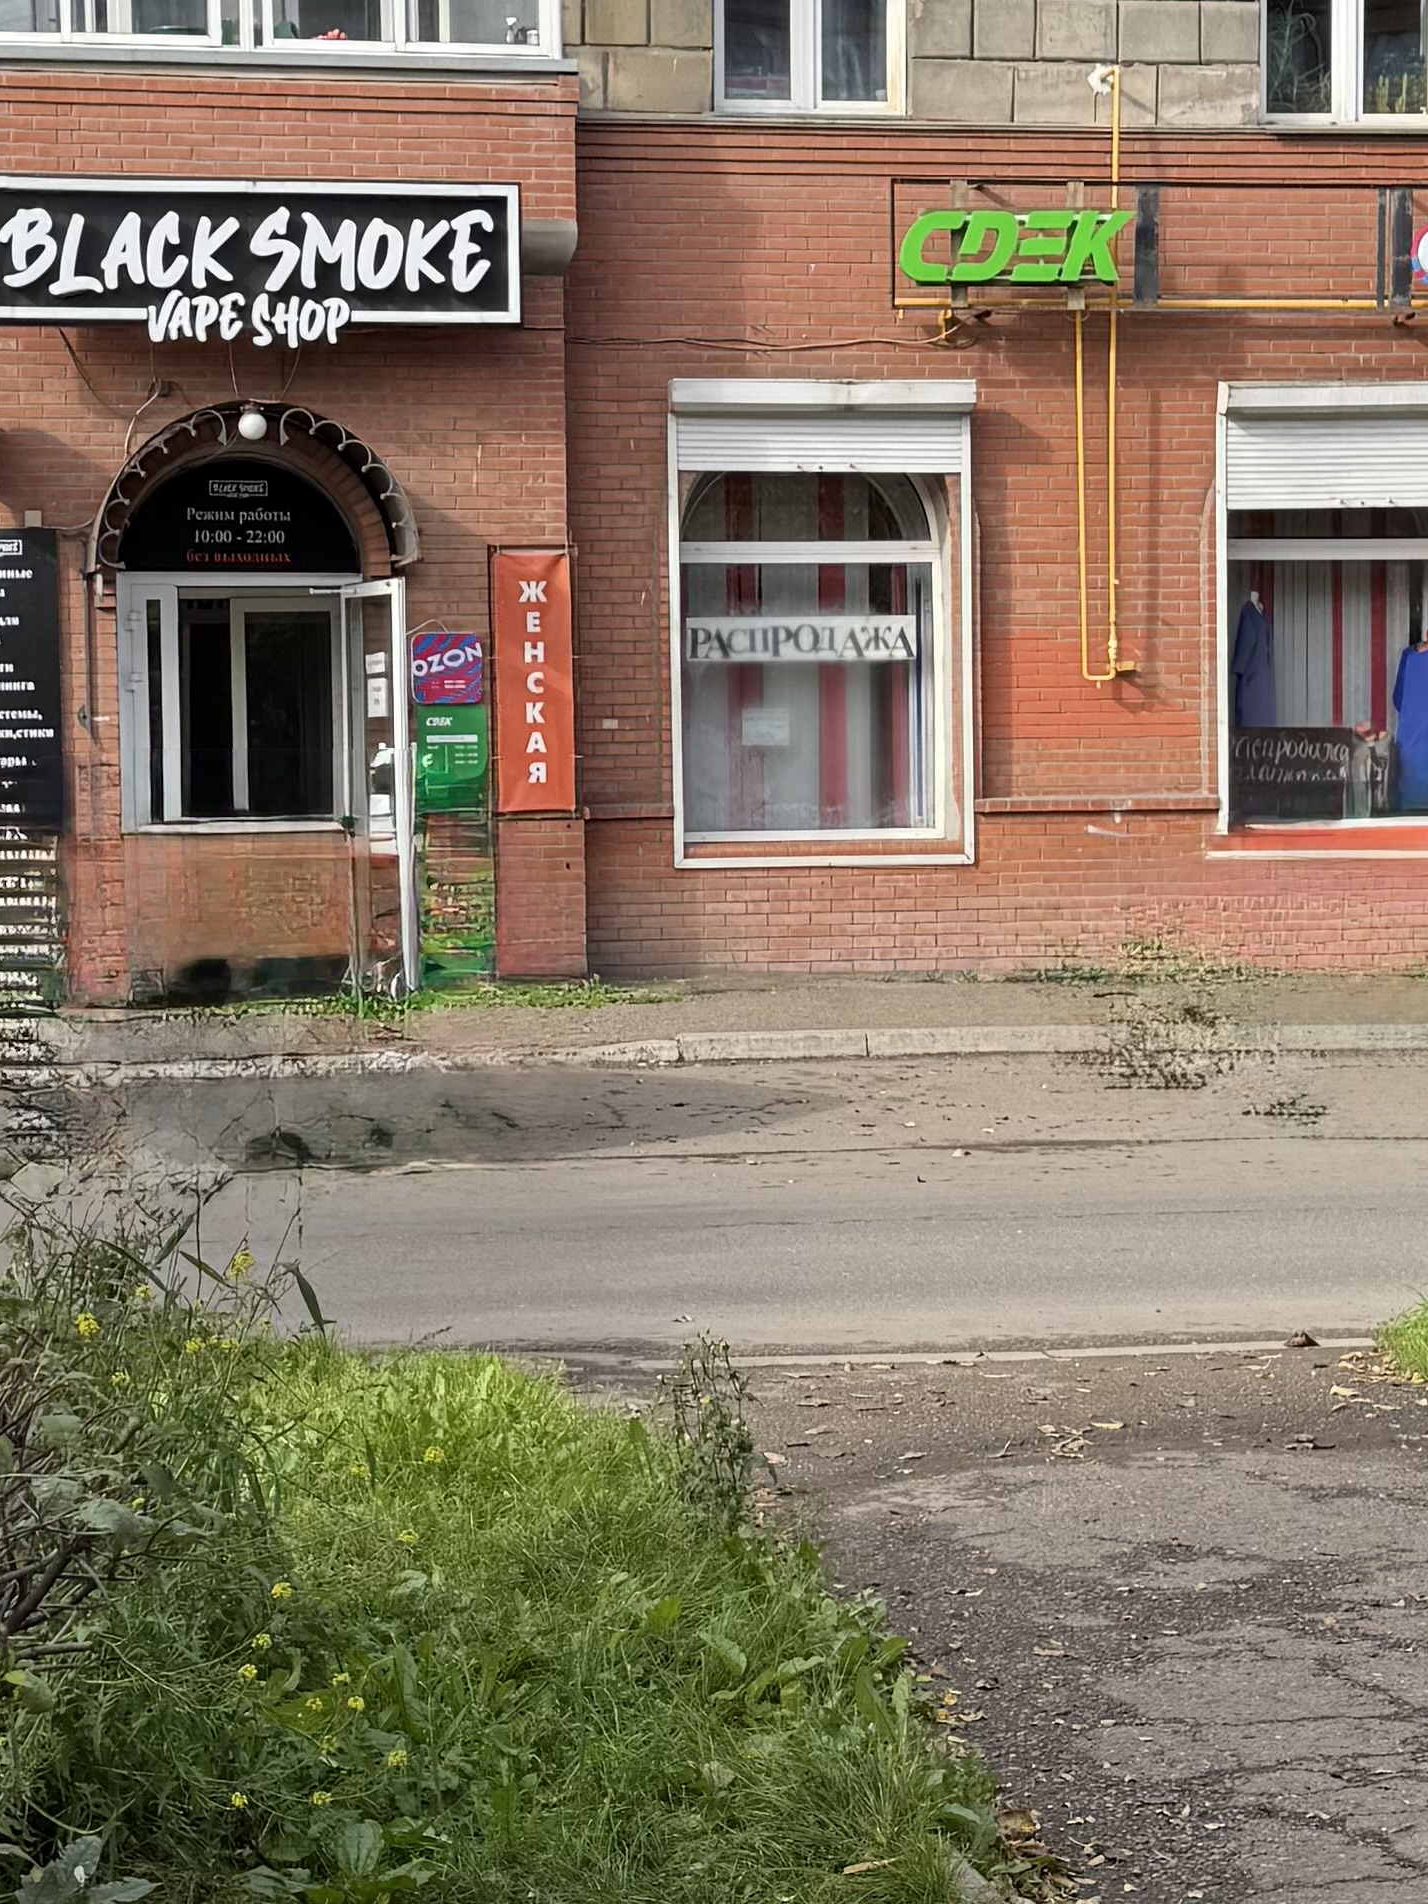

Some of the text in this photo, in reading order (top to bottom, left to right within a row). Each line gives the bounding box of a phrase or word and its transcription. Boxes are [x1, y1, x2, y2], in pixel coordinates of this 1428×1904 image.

[249, 206, 494, 292] SMOKE
[899, 210, 1135, 284] CDEK
[147, 290, 351, 348] VAPE SHOP
[186, 507, 291, 525] Режим работы
[194, 529, 232, 544] 10:00
[245, 529, 285, 544] 22:00
[186, 549, 291, 563] без выходных
[688, 623, 916, 658] РАСПРОДАЖА
[413, 642, 483, 676] OZON
[518, 580, 548, 785] ЖЕНСКАЯ
